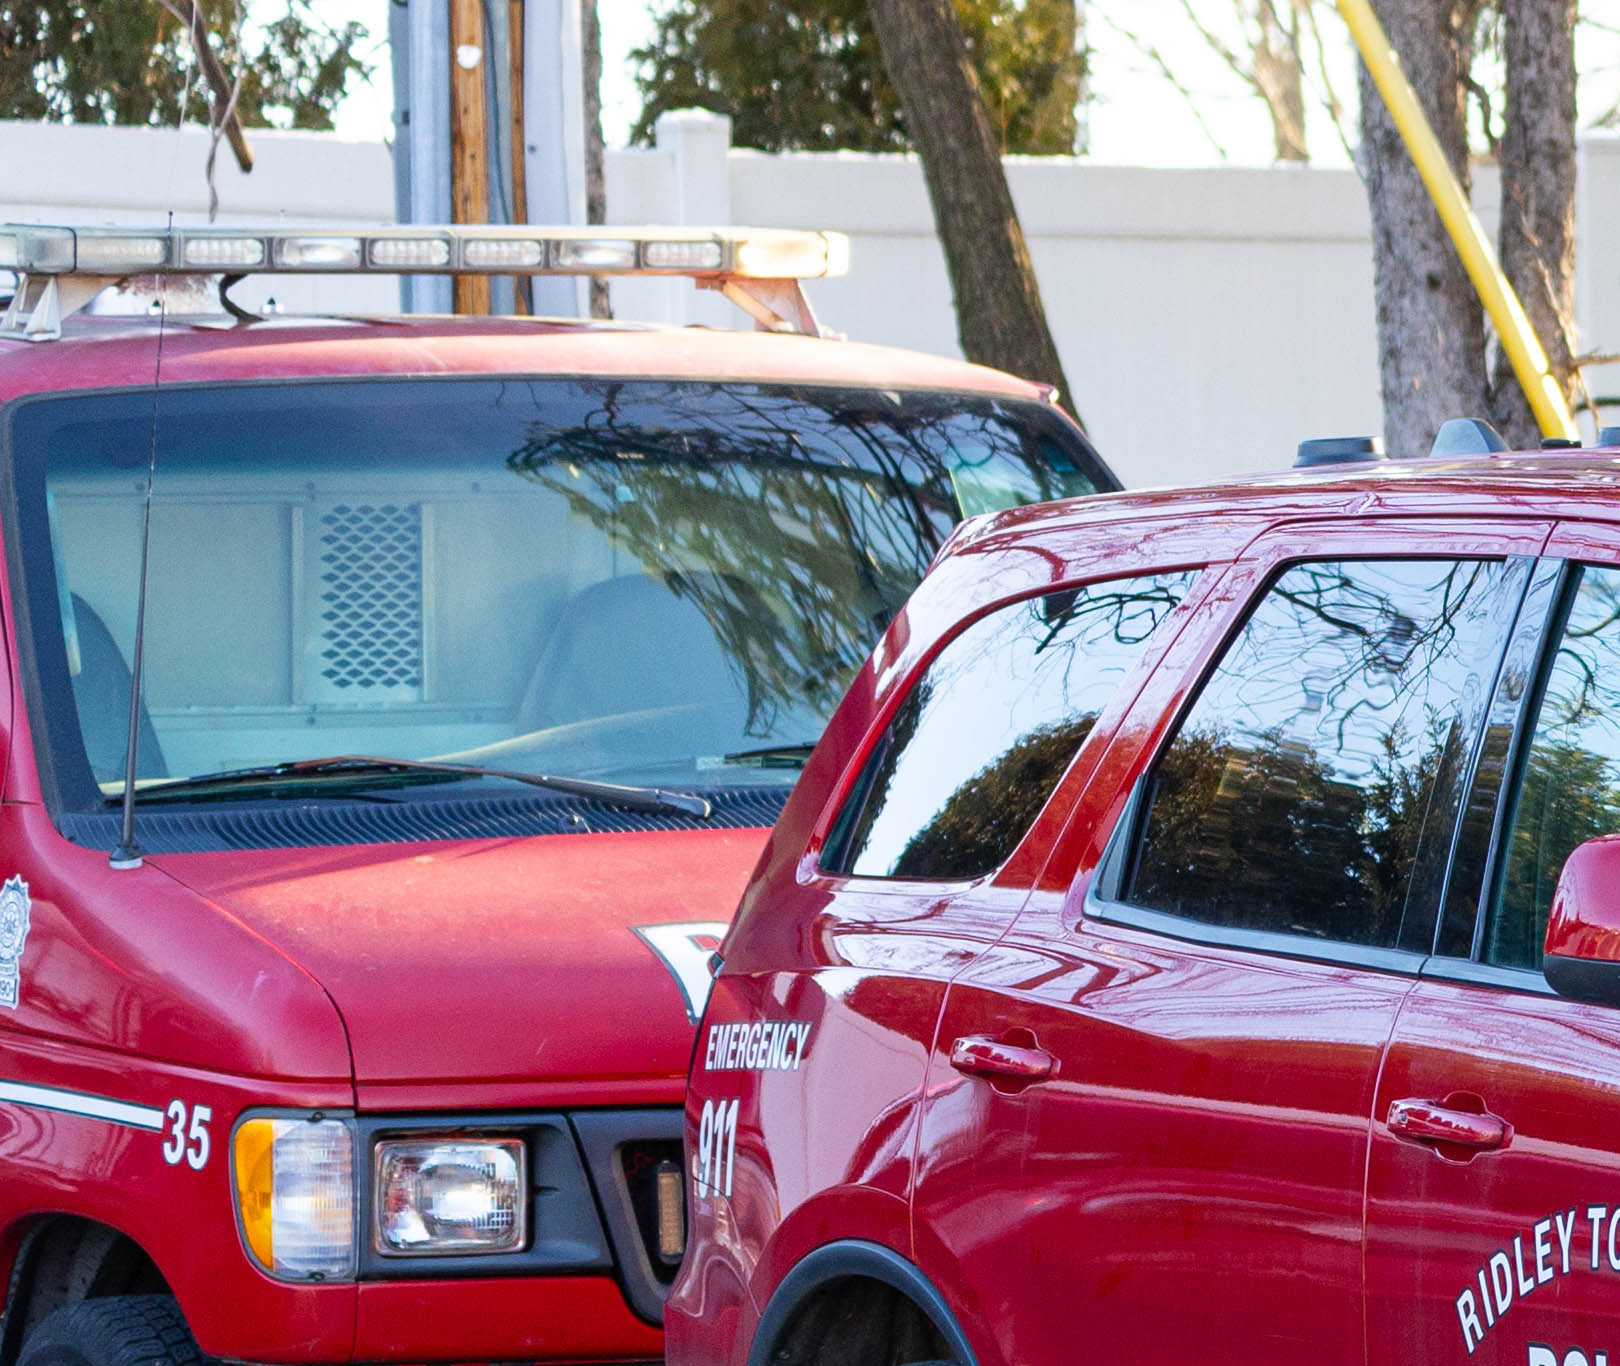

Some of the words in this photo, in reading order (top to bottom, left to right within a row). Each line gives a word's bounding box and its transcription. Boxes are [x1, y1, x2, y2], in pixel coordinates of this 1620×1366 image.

[703, 1020, 812, 1072] EMERGENCY
[162, 1097, 212, 1171] 35
[696, 1097, 740, 1200] 911
[1456, 1207, 1576, 1356] RIDLEY
